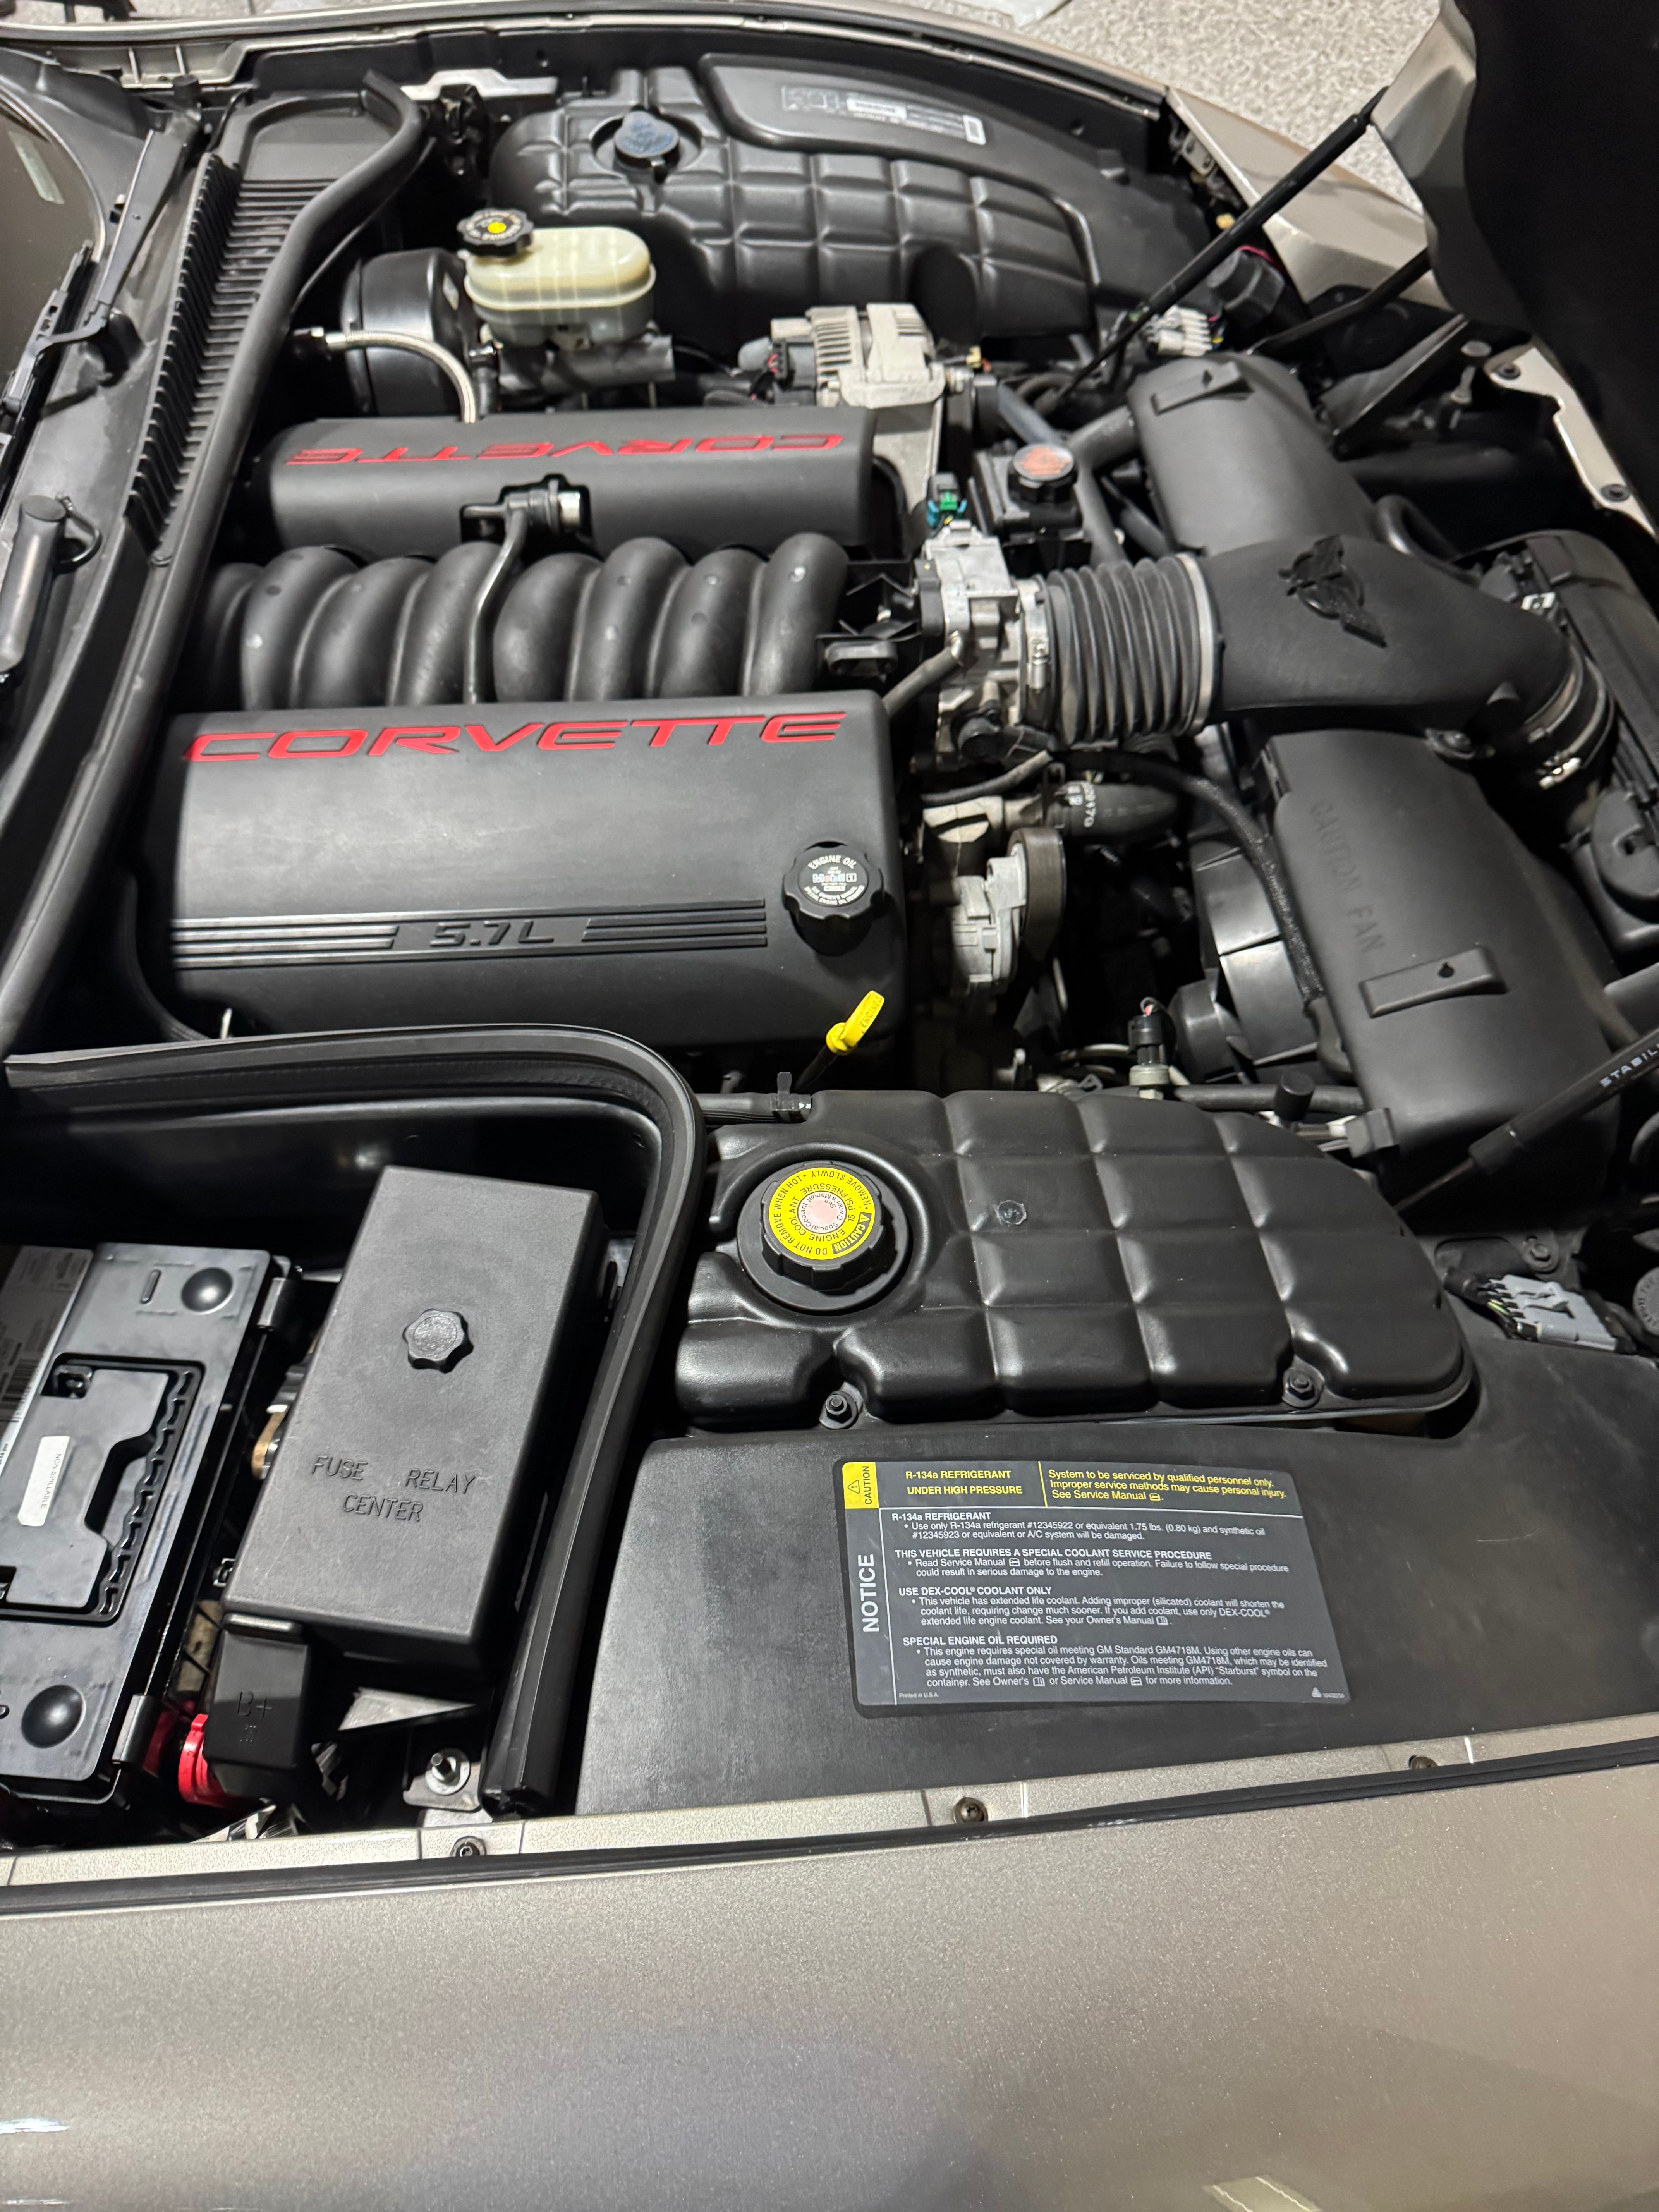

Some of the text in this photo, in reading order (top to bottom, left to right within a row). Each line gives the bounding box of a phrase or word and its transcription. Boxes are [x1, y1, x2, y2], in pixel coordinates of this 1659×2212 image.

[285, 434, 843, 465] CORVETTE
[184, 712, 846, 761] CORVETTE
[808, 855, 857, 870] ENGINE OIL
[430, 921, 554, 948] 5.7L
[1345, 904, 1386, 953] FAN
[786, 1175, 802, 1188] HOT
[811, 1170, 871, 1206] REMOVE SLOWLY
[800, 1183, 848, 1198] PRESSURE
[774, 1188, 789, 1211] WHEN
[845, 1197, 856, 1211] PSI
[789, 1196, 845, 1242] ENGINE COOLANT
[799, 1202, 839, 1232] Special Coolant
[773, 1213, 796, 1244] REMOVE
[834, 1223, 866, 1251] CAUTION
[794, 1241, 812, 1254] NOT
[311, 1455, 477, 1494] FUSE RELAY
[905, 1470, 1011, 1479] R-134a REFRIGERANT
[1048, 1470, 1084, 1480] System
[1085, 1470, 1096, 1479] to
[1097, 1470, 1110, 1479] be
[1111, 1472, 1151, 1480] serviced
[1152, 1472, 1164, 1482] by
[1166, 1474, 1206, 1483] qualified
[1206, 1477, 1252, 1485] personnel
[862, 1465, 873, 1505] CAUTION
[907, 1486, 1023, 1495] UNDER HIGH PRESSURE
[1050, 1480, 1092, 1490] Improper
[1094, 1481, 1127, 1489] service
[1129, 1482, 1170, 1491] methods
[1170, 1484, 1190, 1493] may
[1192, 1485, 1220, 1494] cause
[1221, 1487, 1260, 1496] personal
[1051, 1489, 1147, 1500] See Service Manual
[343, 1494, 424, 1522] CENTER
[891, 1512, 991, 1521] R-134a REFRIGERANT
[912, 1530, 960, 1539] #12345923
[972, 1529, 1015, 1539] equivalent
[1027, 1530, 1043, 1538] A/C
[1044, 1531, 1075, 1540] system
[1091, 1530, 1102, 1539] be
[1103, 1531, 1145, 1541] damaged.
[930, 1522, 948, 1531] only
[950, 1521, 981, 1529] R-134a
[983, 1521, 1025, 1530] refrigerant
[1027, 1521, 1073, 1531] #12345922
[1075, 1523, 1084, 1532] or
[1085, 1522, 1128, 1532] equivalent
[1129, 1523, 1147, 1532] 1.75
[1165, 1524, 1187, 1533] (0.80
[1187, 1525, 1201, 1534] kg)
[1219, 1527, 1254, 1535] synthetic
[894, 1548, 1212, 1560] THIS VEHICLE REQUIRES A SPECIAL COOLANT SERVICE PROCEDURE
[915, 1568, 939, 1577] could
[941, 1568, 965, 1576] result
[967, 1567, 975, 1575] in
[977, 1567, 1008, 1576] serious
[1009, 1568, 1044, 1577] damage
[1072, 1568, 1103, 1578] engine.
[857, 1553, 880, 1632] NOTICE
[898, 1587, 919, 1596] USE
[977, 1586, 1024, 1595] COOLANT
[1026, 1586, 1051, 1595] ONLY
[920, 1607, 952, 1615] coolant
[954, 1606, 970, 1615] life,
[972, 1606, 1010, 1616] requiring
[1011, 1606, 1043, 1616] change
[1045, 1606, 1069, 1616] much
[1071, 1607, 1103, 1616] sooner.
[1112, 1607, 1128, 1616] you
[1130, 1606, 1146, 1614] add
[1148, 1607, 1181, 1616] coolant,
[1199, 1608, 1217, 1617] only
[921, 1616, 961, 1626] extended
[963, 1616, 976, 1625] life
[978, 1616, 1007, 1626] engine
[1045, 1616, 1063, 1624] See
[1065, 1617, 1084, 1626] your
[1085, 1616, 1121, 1624] Owner's
[1122, 1616, 1154, 1625] Manual
[902, 1635, 1058, 1646] SPECIAL ENGINE OIL REQUIRED
[923, 1647, 943, 1656] This
[945, 1647, 975, 1656] engine
[977, 1647, 1013, 1656] requires
[1015, 1646, 1045, 1656] special
[1047, 1645, 1058, 1654] oil
[1059, 1646, 1095, 1656] meeting
[1096, 1645, 1113, 1654] GM
[1114, 1645, 1154, 1654] Standard
[1155, 1645, 1202, 1654] GM4718M.
[1203, 1646, 1228, 1657] Using
[1229, 1647, 1251, 1656] other
[1252, 1648, 1280, 1657] engine
[1281, 1648, 1297, 1657] oils
[926, 1677, 970, 1687] container.
[972, 1677, 990, 1686] See
[992, 1676, 1029, 1686] Owner's
[1060, 1676, 1093, 1685] Service
[1095, 1676, 1128, 1685] Manual
[1145, 1676, 1158, 1685] for
[1183, 1676, 1233, 1685] information.
[237, 1690, 273, 1718] B+
